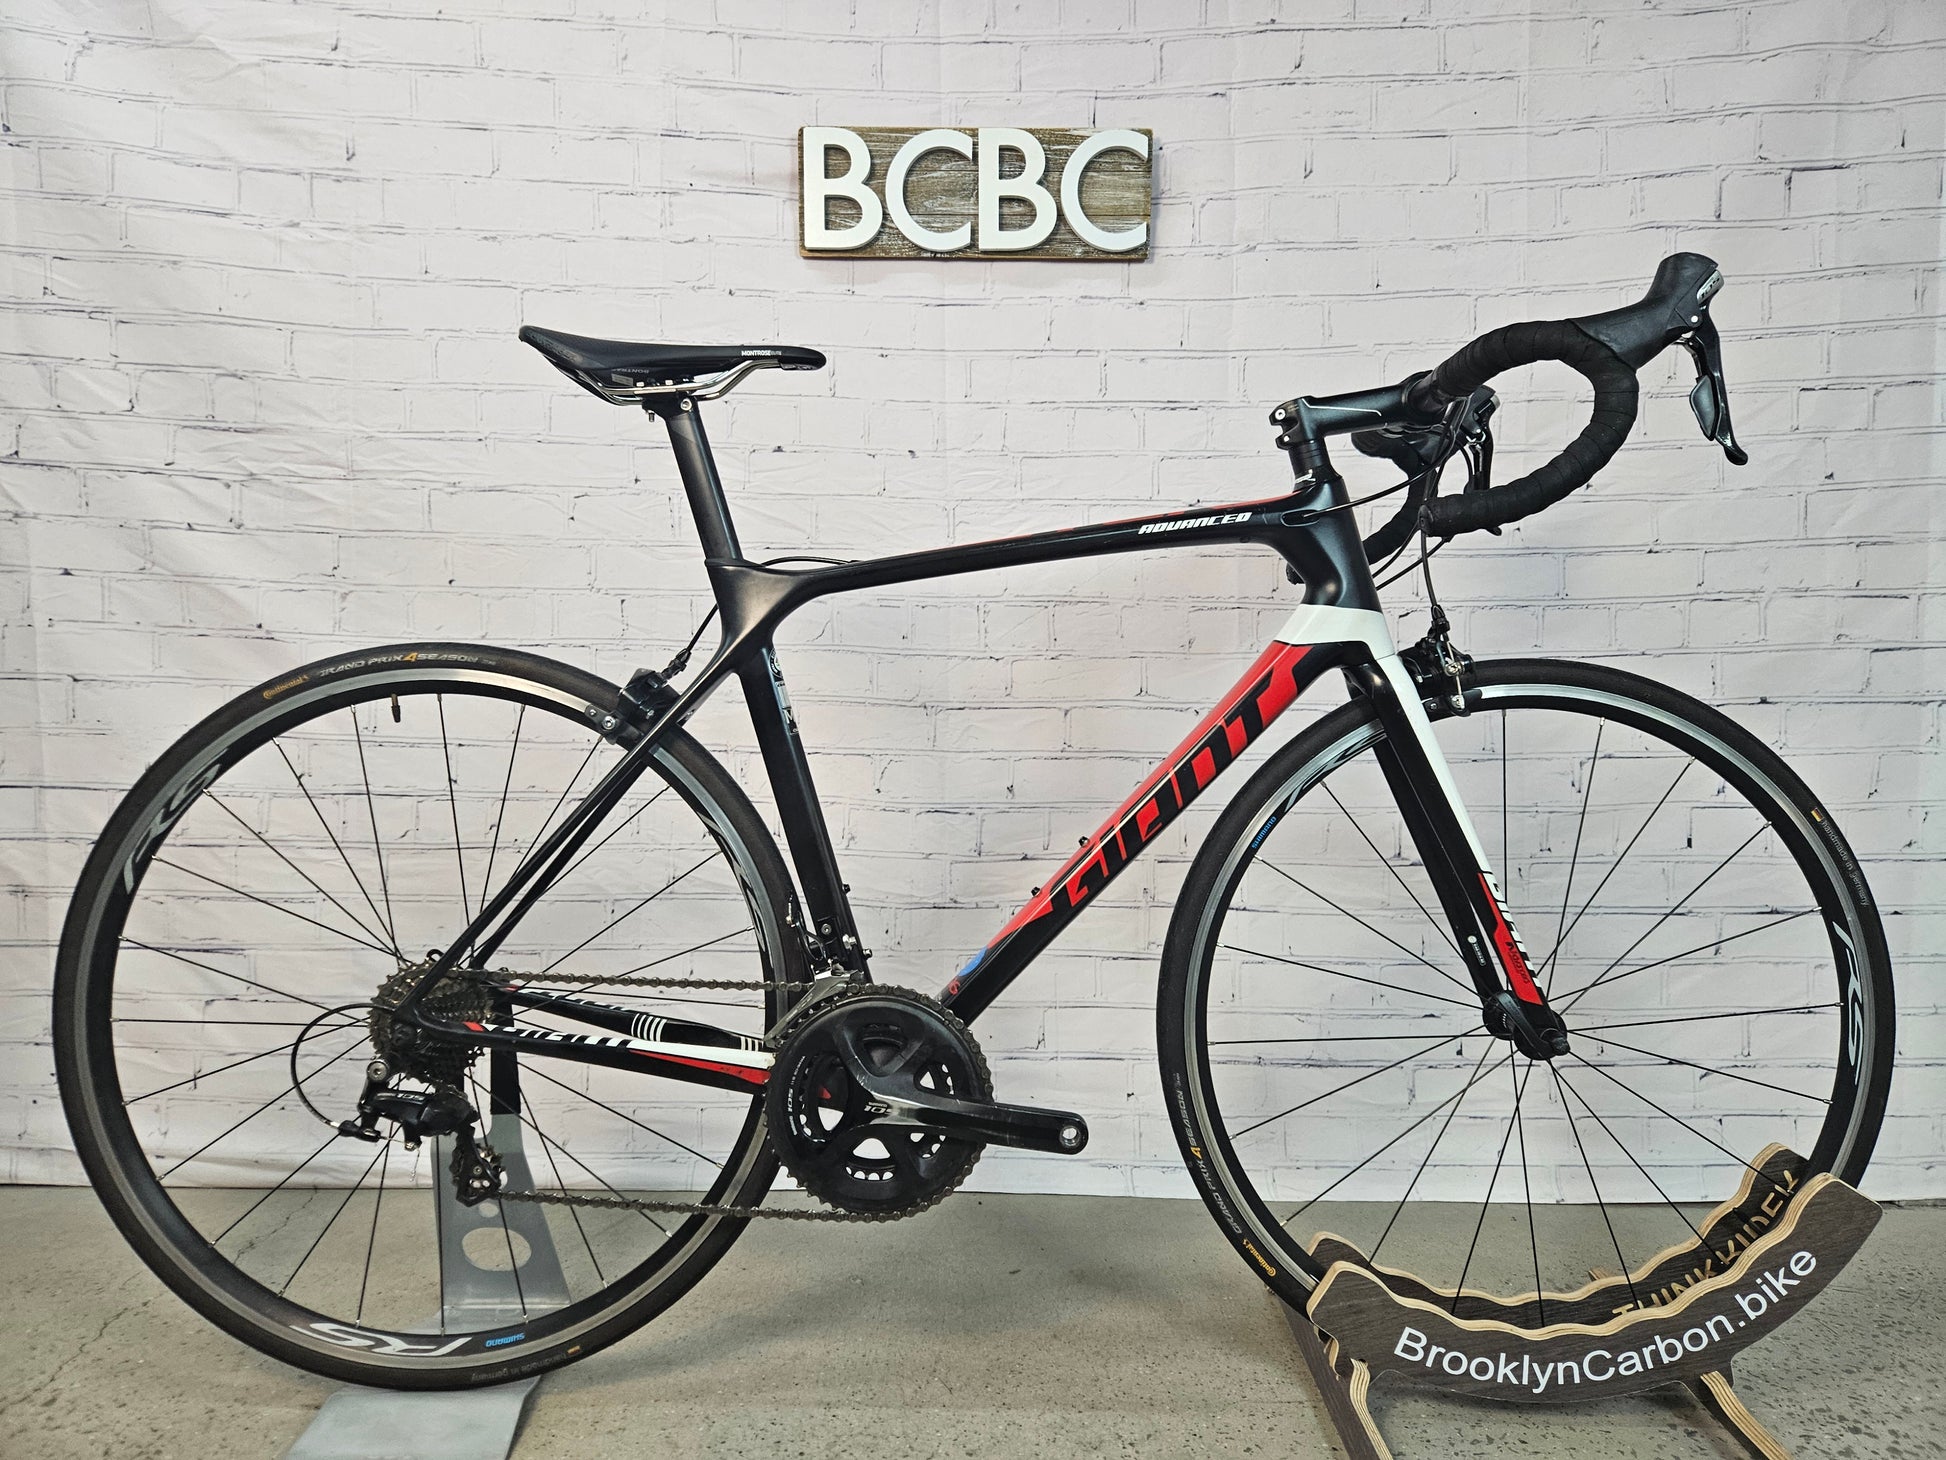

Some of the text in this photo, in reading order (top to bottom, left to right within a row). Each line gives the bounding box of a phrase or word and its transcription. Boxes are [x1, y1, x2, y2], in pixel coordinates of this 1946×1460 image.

[802, 126, 1149, 252] BCBC
[1138, 511, 1253, 535] ADVANCED
[1048, 667, 1277, 926] GIANT
[1393, 1250, 1817, 1394] BrooklynCarbon.bike
